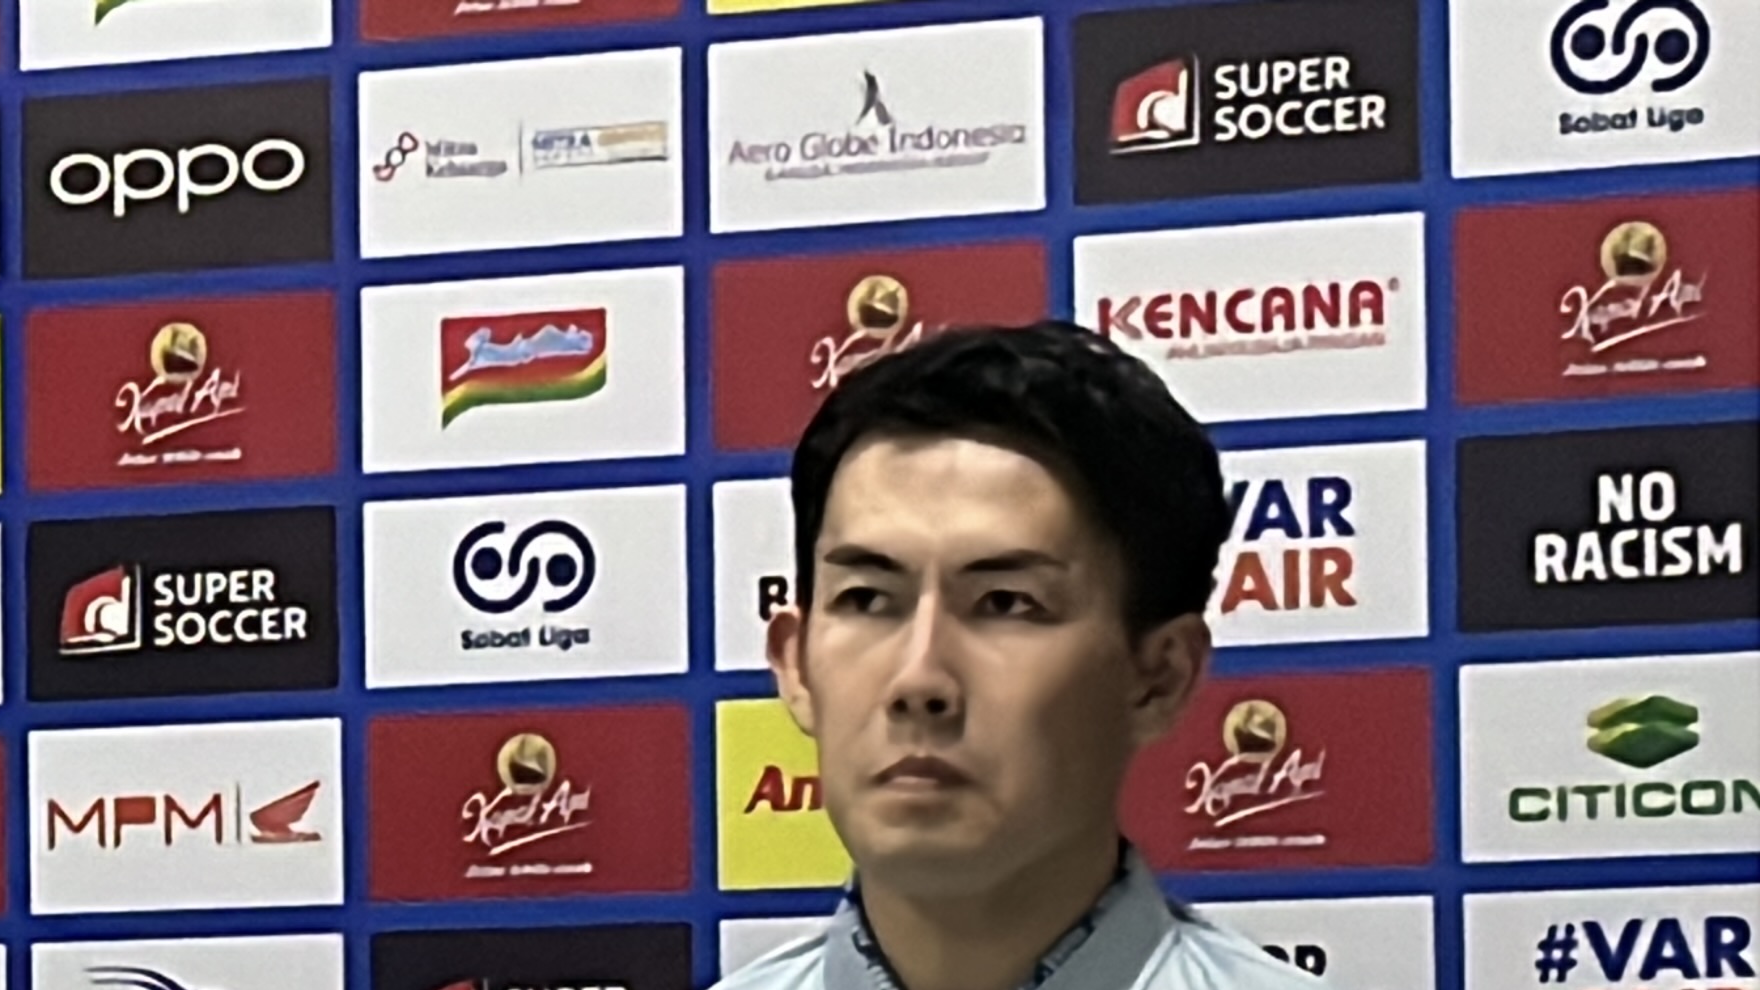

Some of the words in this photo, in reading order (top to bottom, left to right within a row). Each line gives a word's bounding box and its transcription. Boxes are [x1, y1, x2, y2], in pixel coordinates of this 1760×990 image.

[1214, 55, 1351, 101] SUPER
[1214, 95, 1387, 144] SOCCER
[1559, 108, 1637, 135] Sobat
[1647, 104, 1705, 133] Liga
[50, 138, 305, 217] oppo
[1098, 280, 1386, 341] KENCANA
[1597, 470, 1677, 525] NO
[1220, 547, 1357, 614] AIR
[1534, 522, 1744, 585] RACISM
[154, 568, 275, 606] SUPER
[154, 605, 308, 646] SOCCER
[461, 628, 532, 652] Sobat
[539, 624, 591, 652] Liga
[48, 793, 222, 851] MPM
[1535, 915, 1756, 983] #VAR
